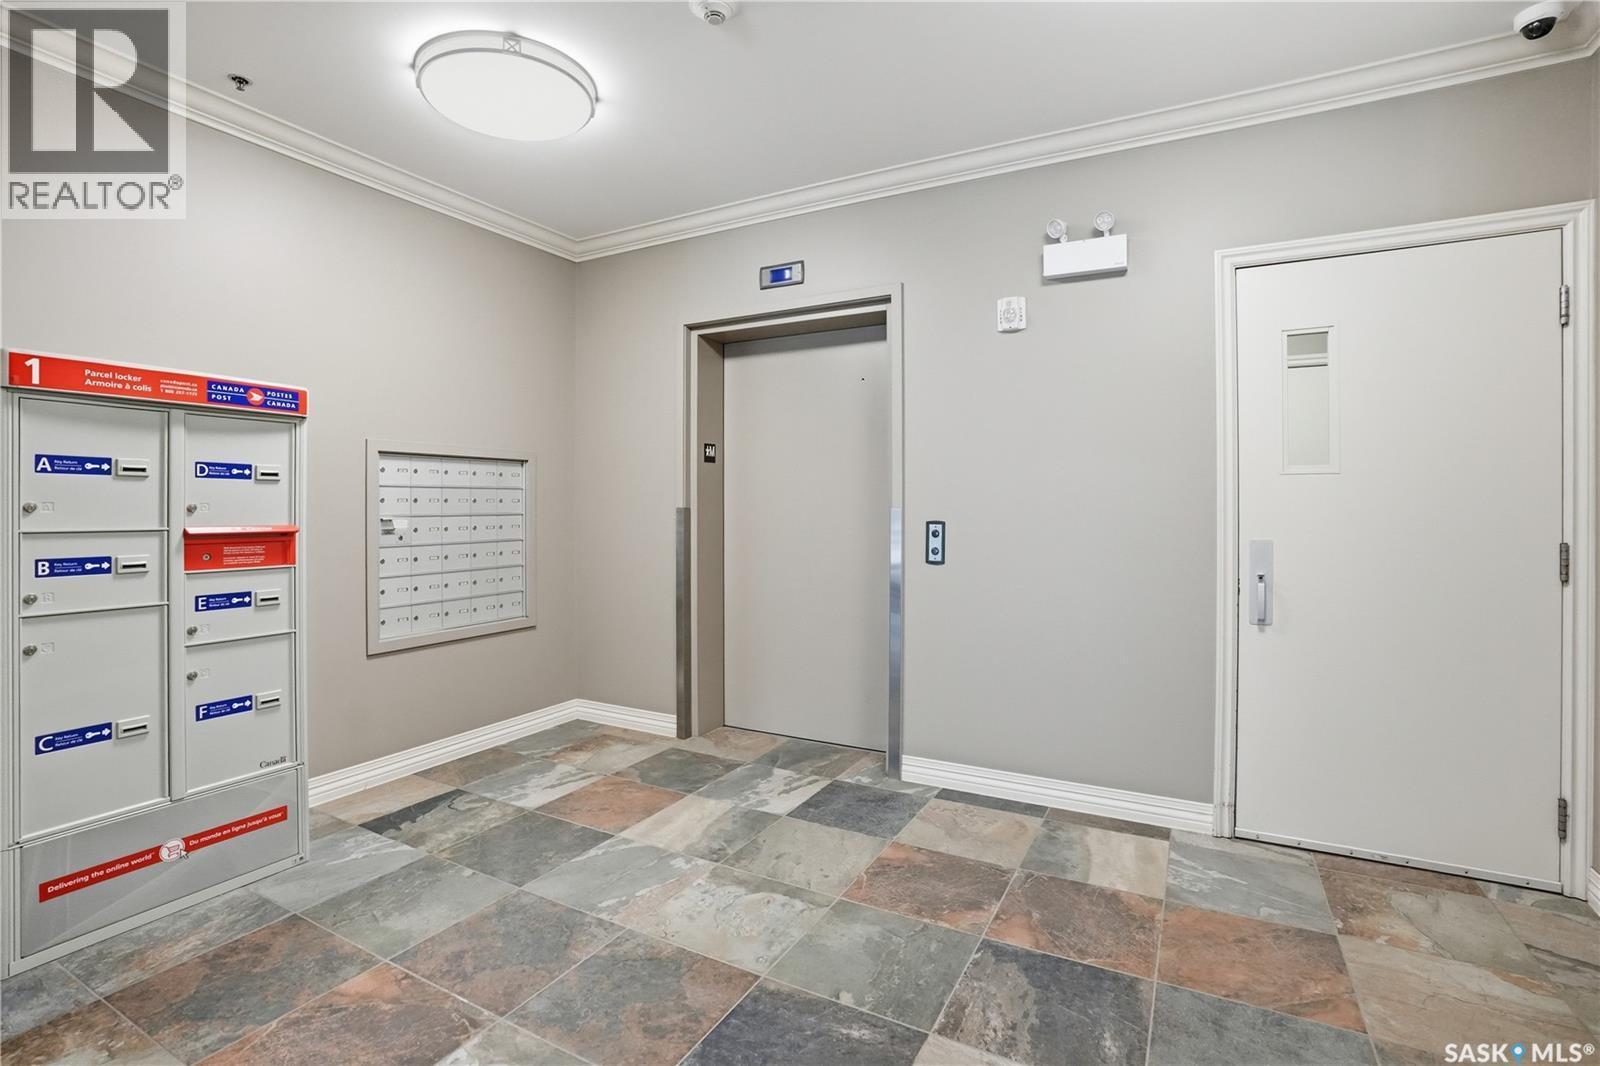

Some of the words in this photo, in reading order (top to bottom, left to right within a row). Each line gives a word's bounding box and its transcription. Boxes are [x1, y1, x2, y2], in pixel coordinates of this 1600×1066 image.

[24, 358, 40, 385] 1
[84, 369, 113, 379] Parcel
[115, 371, 142, 382] locker
[84, 378, 123, 389] Armoire
[132, 384, 153, 393] colis
[211, 384, 245, 393] CANADA
[211, 394, 232, 402] POST
[266, 391, 293, 399] POSTES
[266, 400, 296, 409] CANADA
[36, 457, 52, 472] A
[196, 464, 209, 477] D
[37, 561, 50, 576] B
[198, 597, 207, 610] E
[199, 705, 208, 719] F
[38, 735, 54, 751] C
[200, 831, 222, 843] monde
[231, 823, 247, 833] ligne
[47, 874, 90, 893] Delivering
[91, 870, 105, 879] the
[105, 861, 130, 874] online
